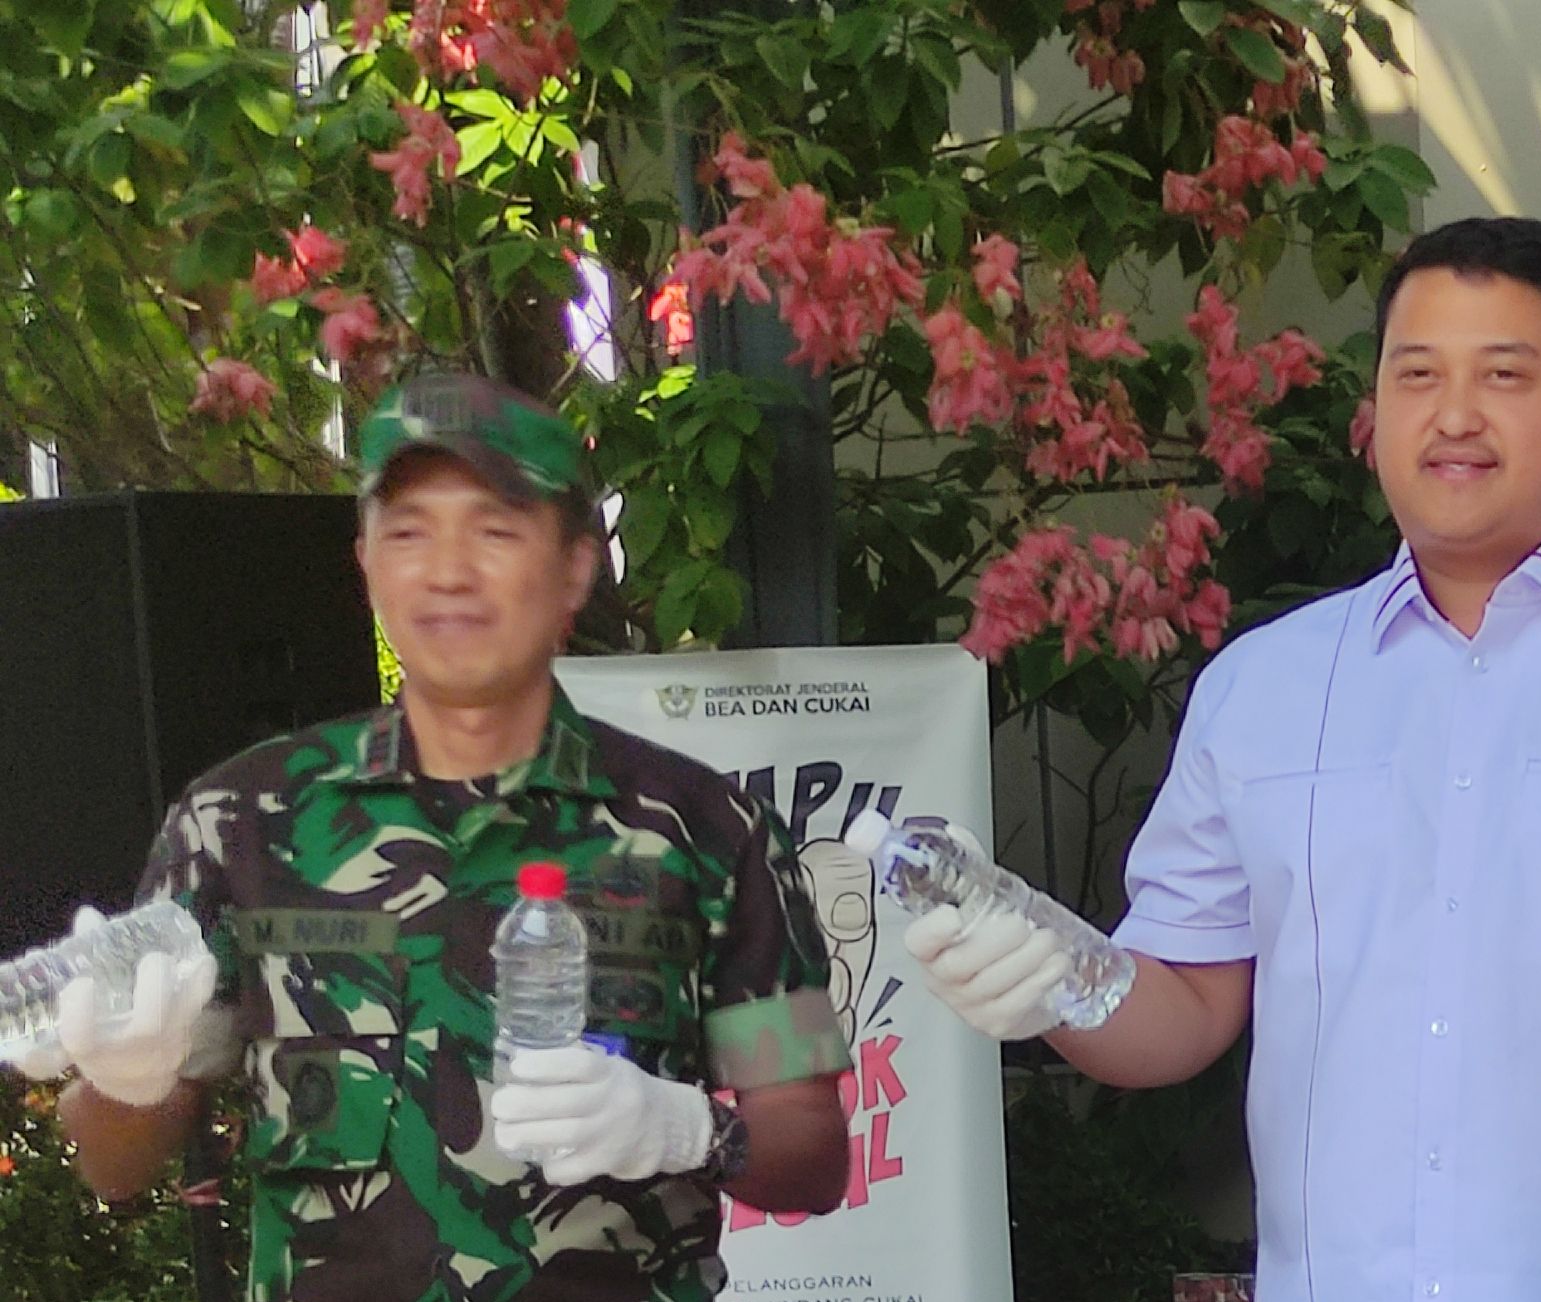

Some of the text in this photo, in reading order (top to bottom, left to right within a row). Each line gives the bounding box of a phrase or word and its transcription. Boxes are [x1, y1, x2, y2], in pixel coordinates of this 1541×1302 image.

[796, 681, 869, 696] JENDERAL
[704, 696, 871, 717] BEA DAN CUKAI
